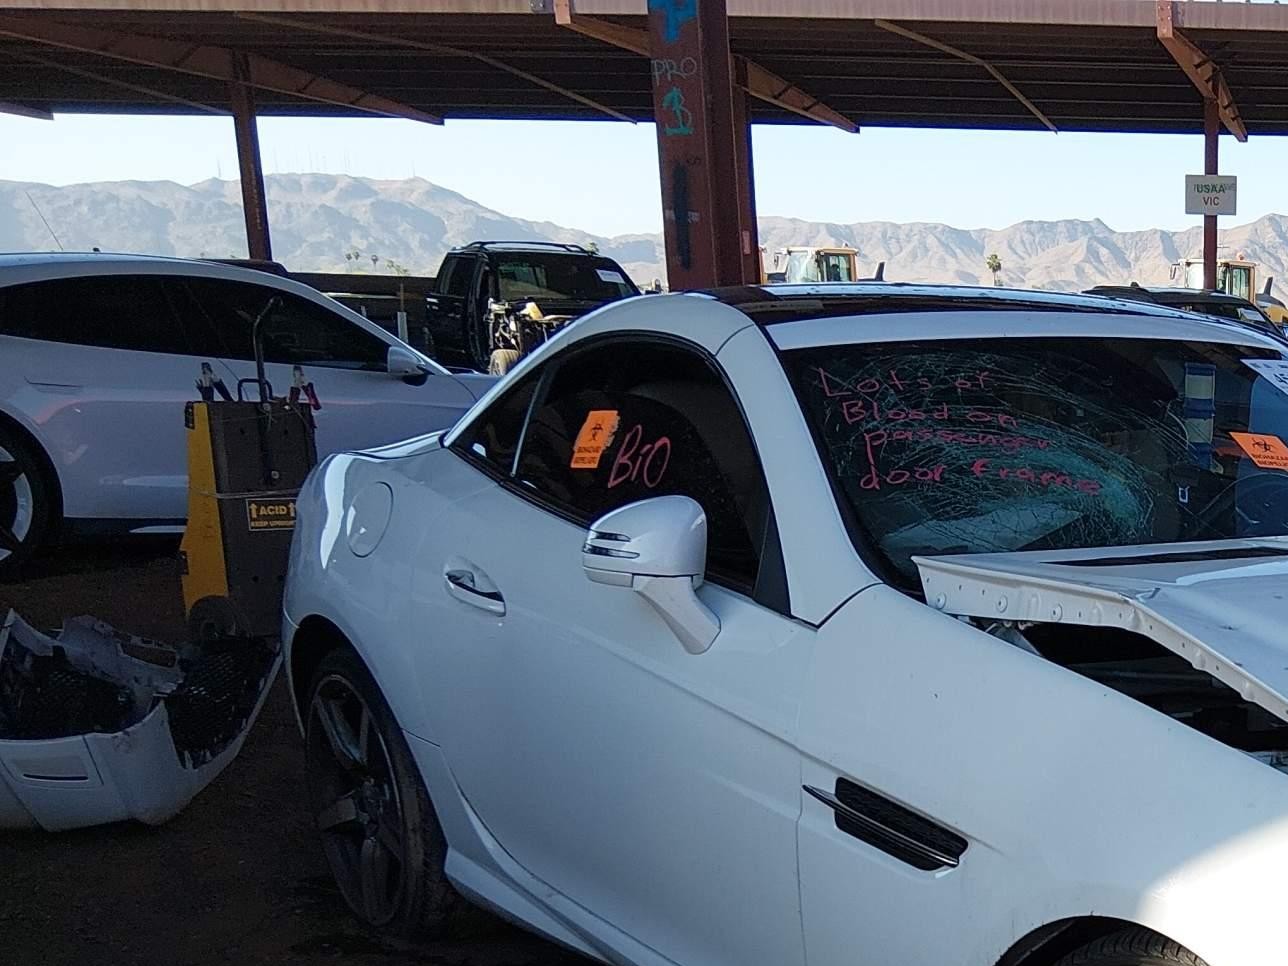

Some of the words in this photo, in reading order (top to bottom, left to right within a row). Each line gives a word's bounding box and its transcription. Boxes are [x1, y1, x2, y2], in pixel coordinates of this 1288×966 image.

[1202, 196, 1221, 206] VIC
[819, 368, 930, 396] Lots
[842, 401, 950, 425] Blood
[967, 411, 1019, 428] on
[860, 463, 946, 490] door
[259, 504, 288, 515] ACID
